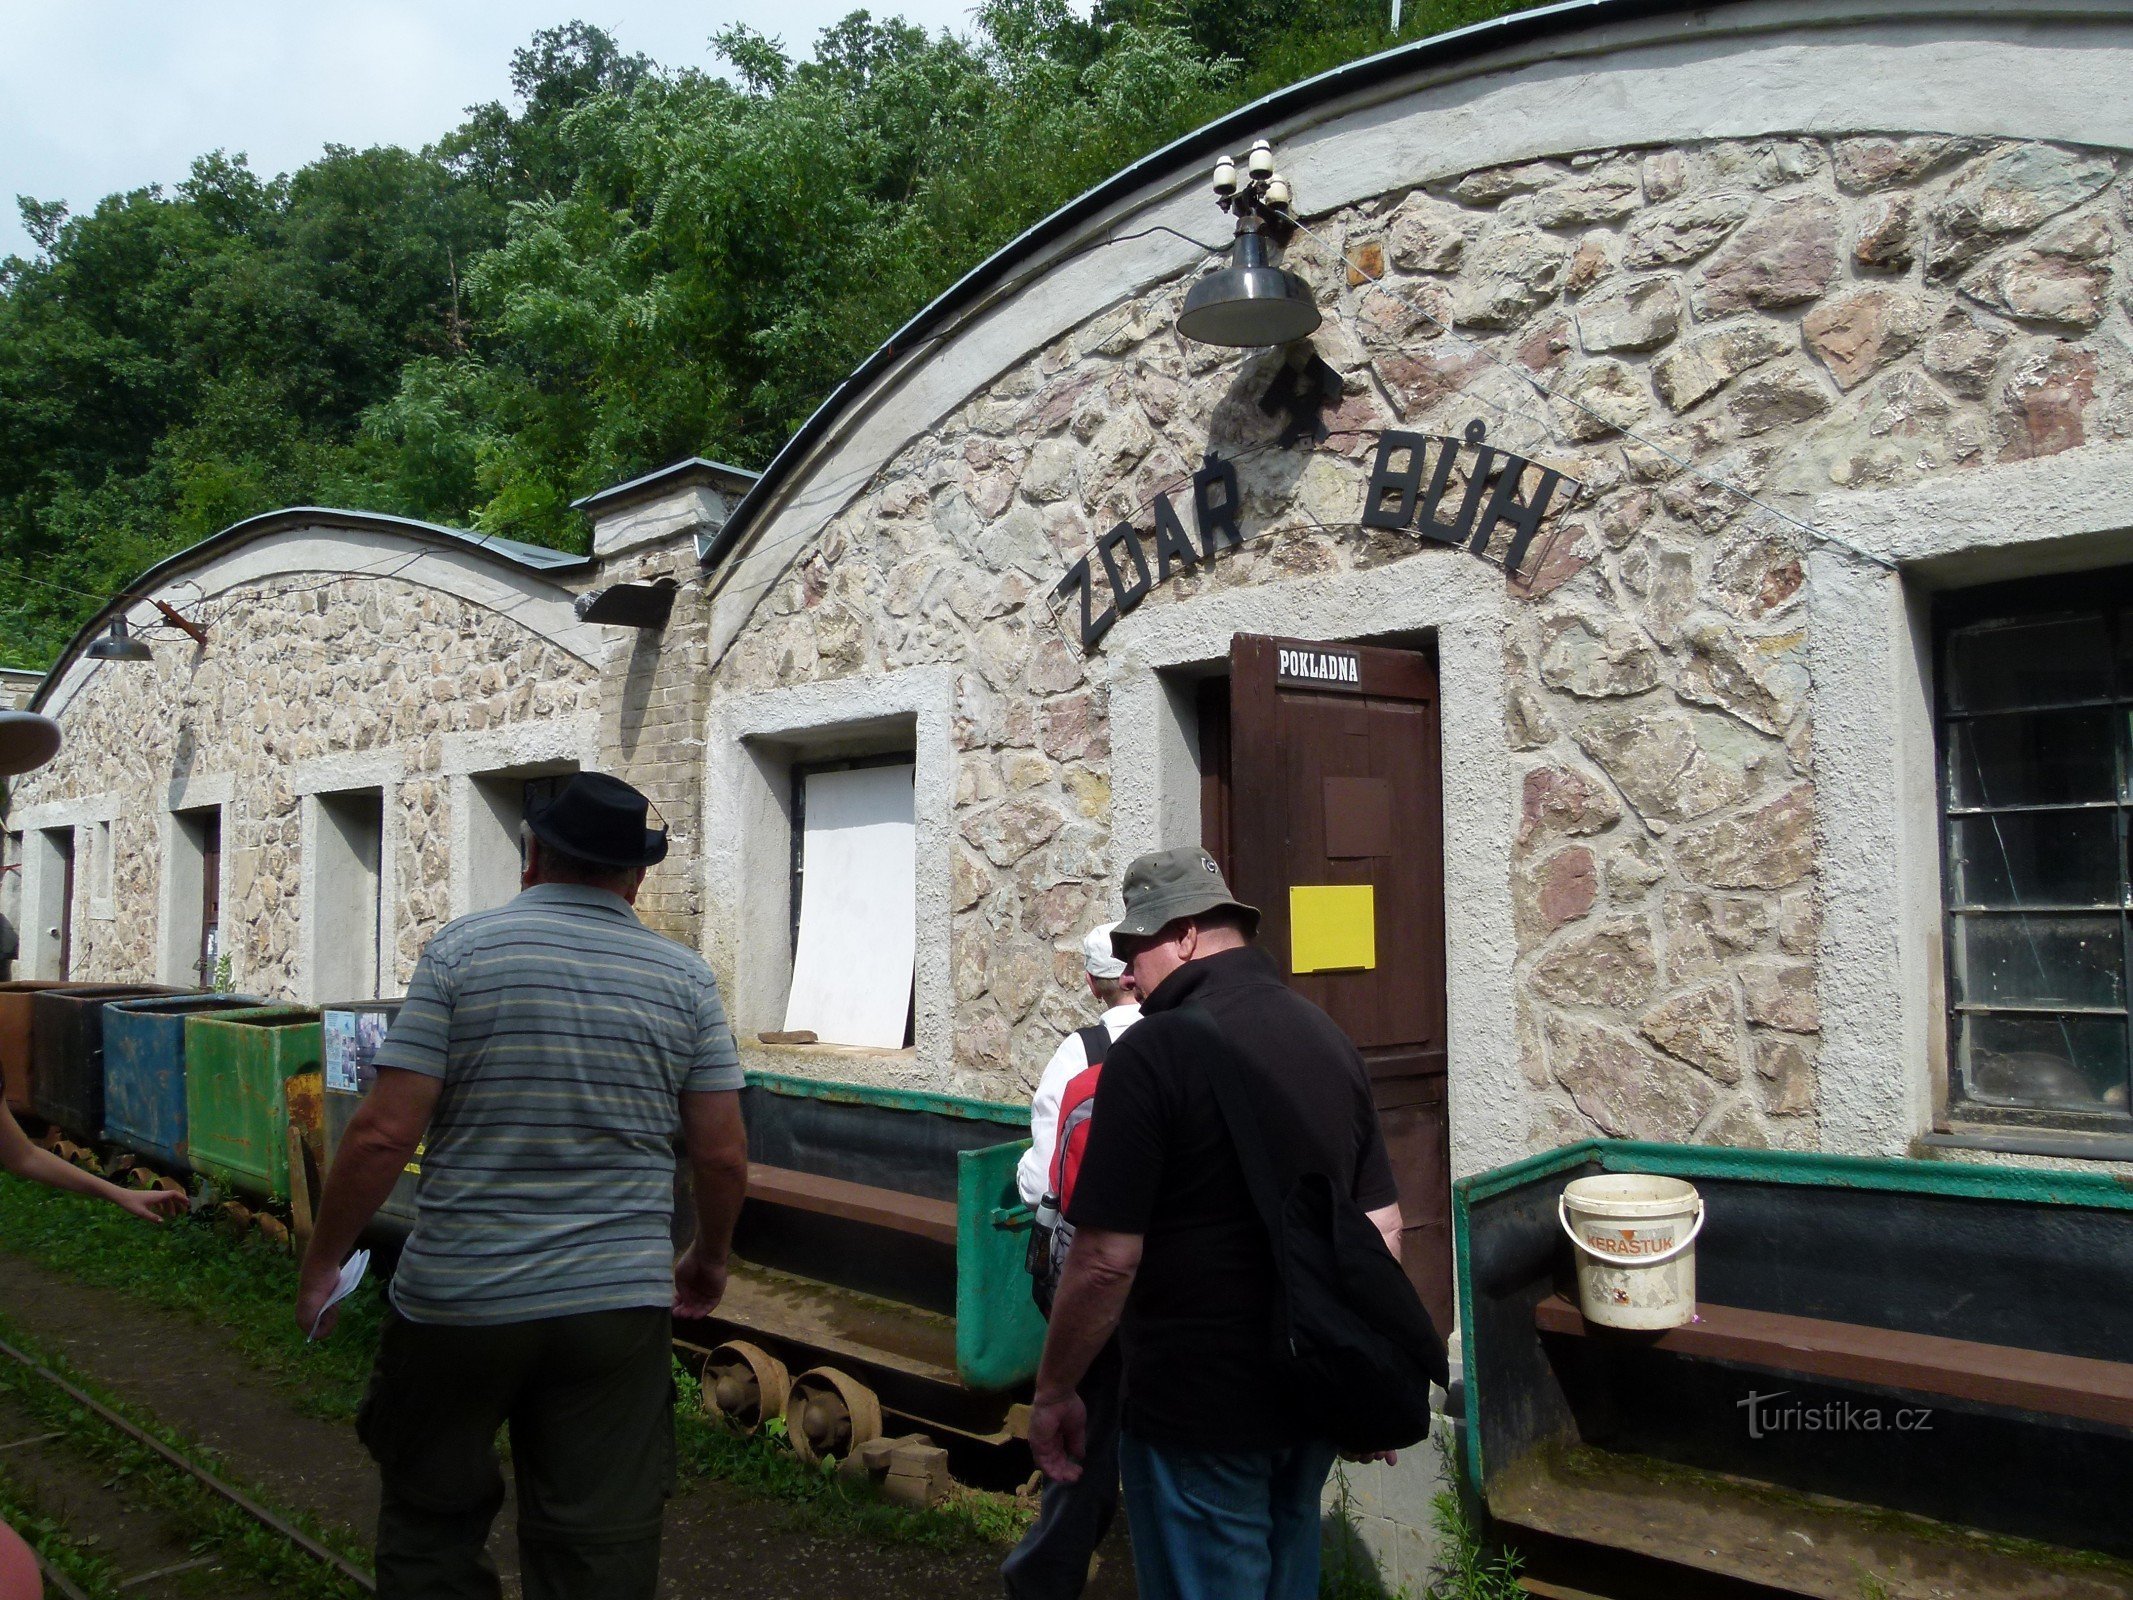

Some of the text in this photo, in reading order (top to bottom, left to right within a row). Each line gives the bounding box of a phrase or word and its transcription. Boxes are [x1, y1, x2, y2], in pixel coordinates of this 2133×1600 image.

[1056, 418, 1562, 646] ZDAŘ BŮH
[1279, 649, 1358, 682] POKLADNA
[1587, 1235, 1673, 1254] KERASTUK
